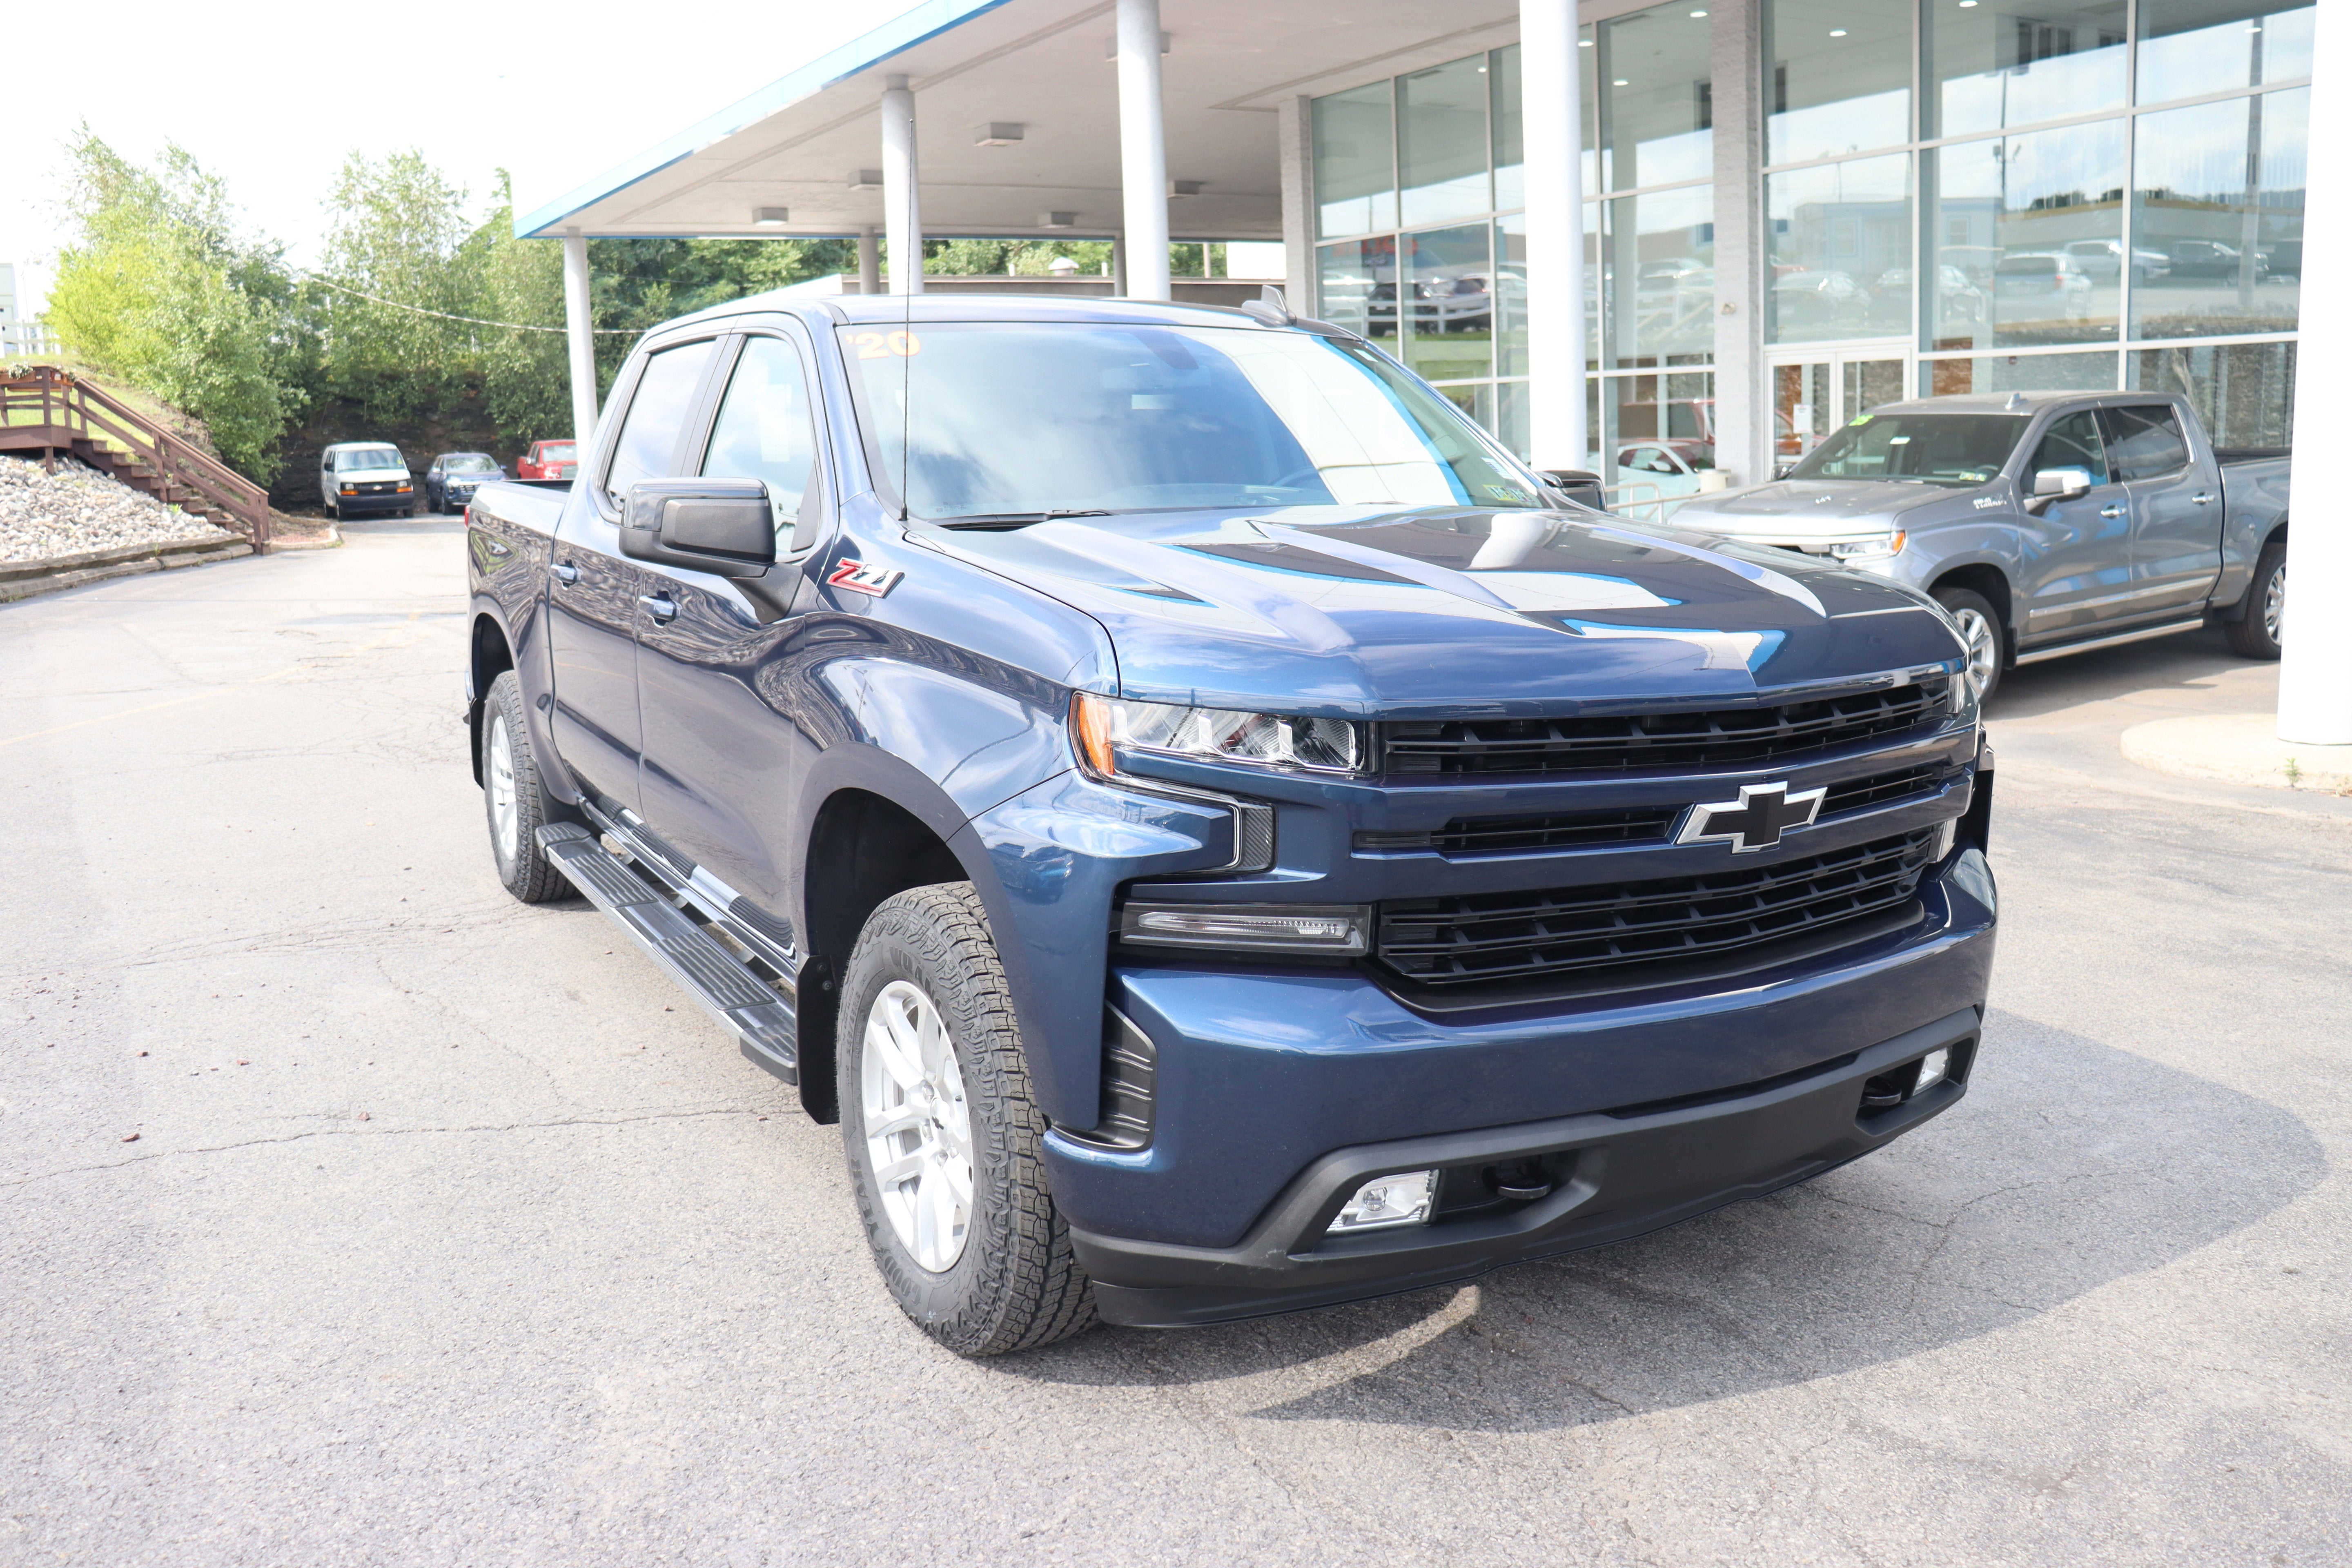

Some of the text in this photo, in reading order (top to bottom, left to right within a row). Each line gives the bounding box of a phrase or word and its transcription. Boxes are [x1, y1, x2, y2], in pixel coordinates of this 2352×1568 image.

[845, 330, 922, 360] '20
[826, 557, 905, 598] Z71
[889, 946, 967, 1088] WRANGLER
